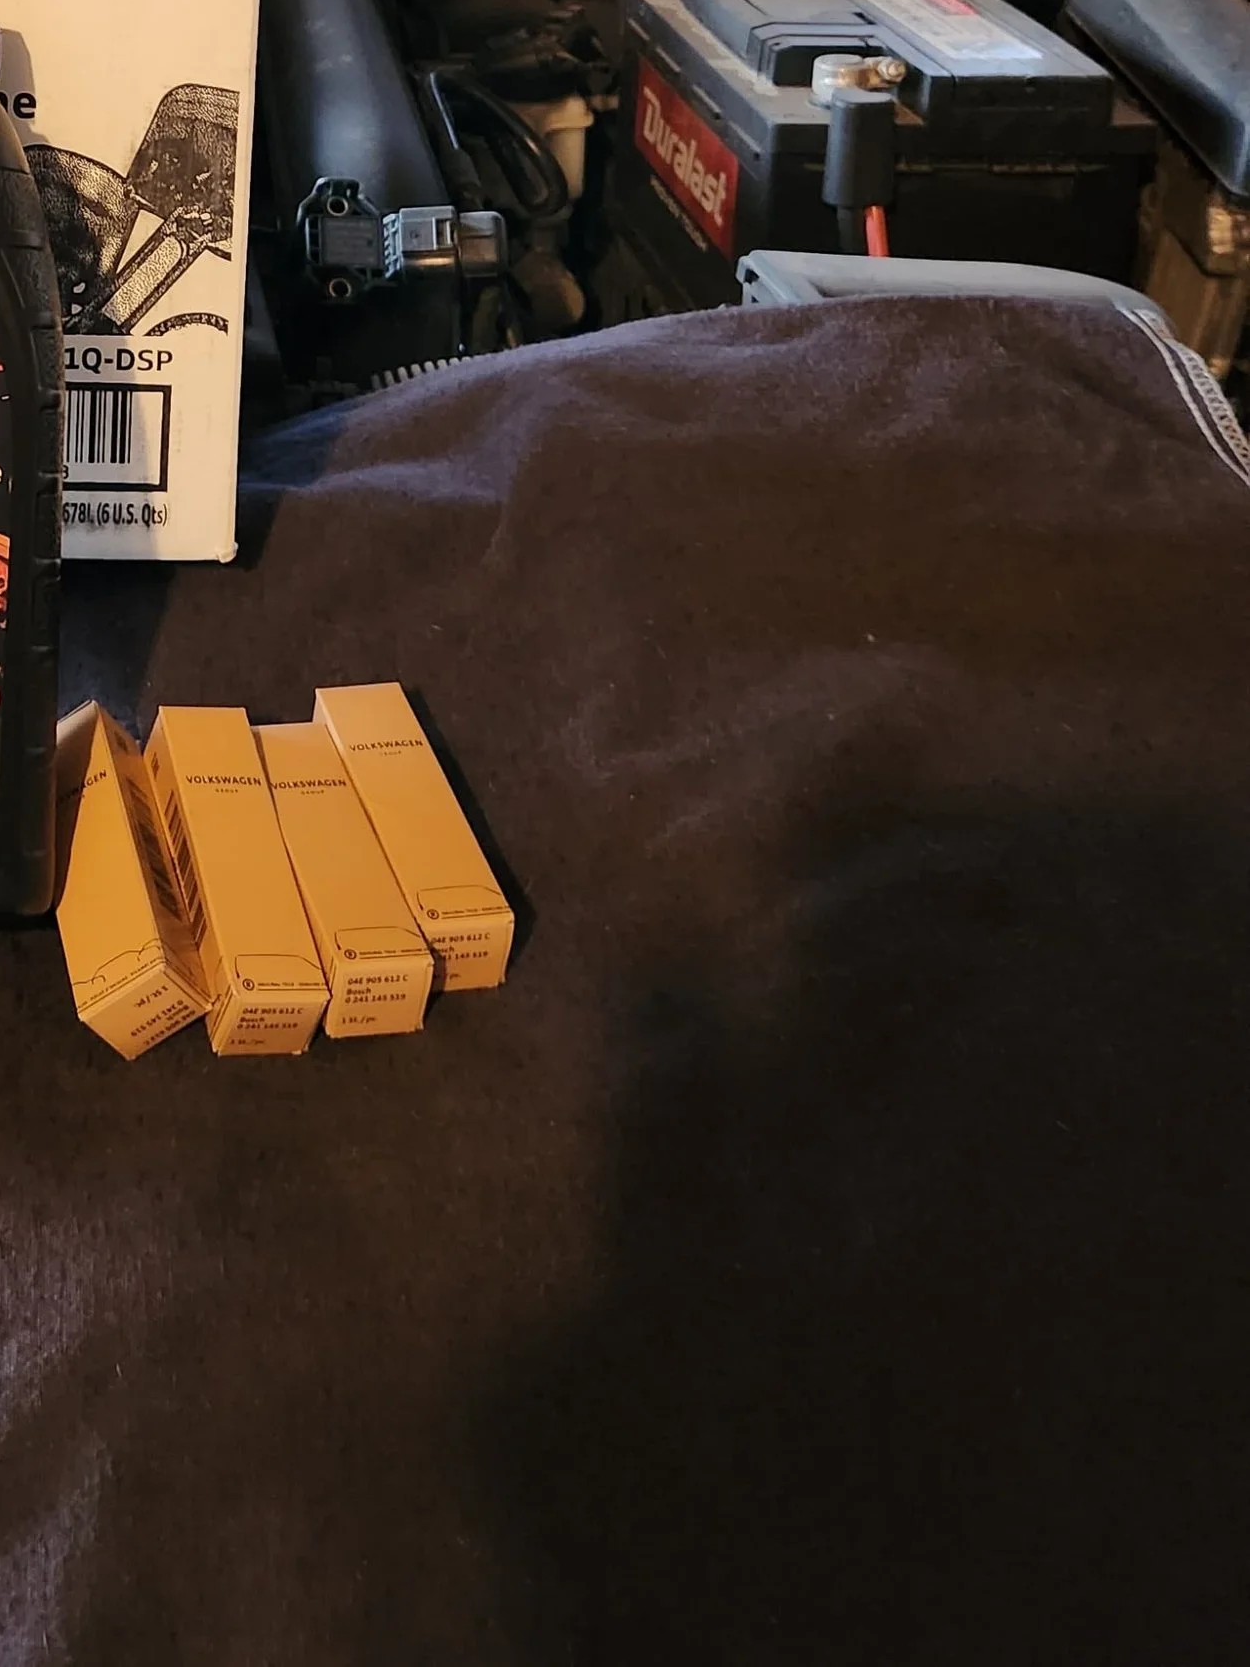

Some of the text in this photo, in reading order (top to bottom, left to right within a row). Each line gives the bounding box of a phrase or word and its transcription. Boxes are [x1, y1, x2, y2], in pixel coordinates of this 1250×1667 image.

[643, 85, 728, 228] Duralast
[64, 346, 174, 375] 1Q-DSP
[141, 503, 169, 528] Qts)
[350, 738, 424, 752] VOLKSWAGEN
[185, 774, 262, 786] VOLKSWAGEN
[270, 779, 347, 790] VOLKSWAGEN
